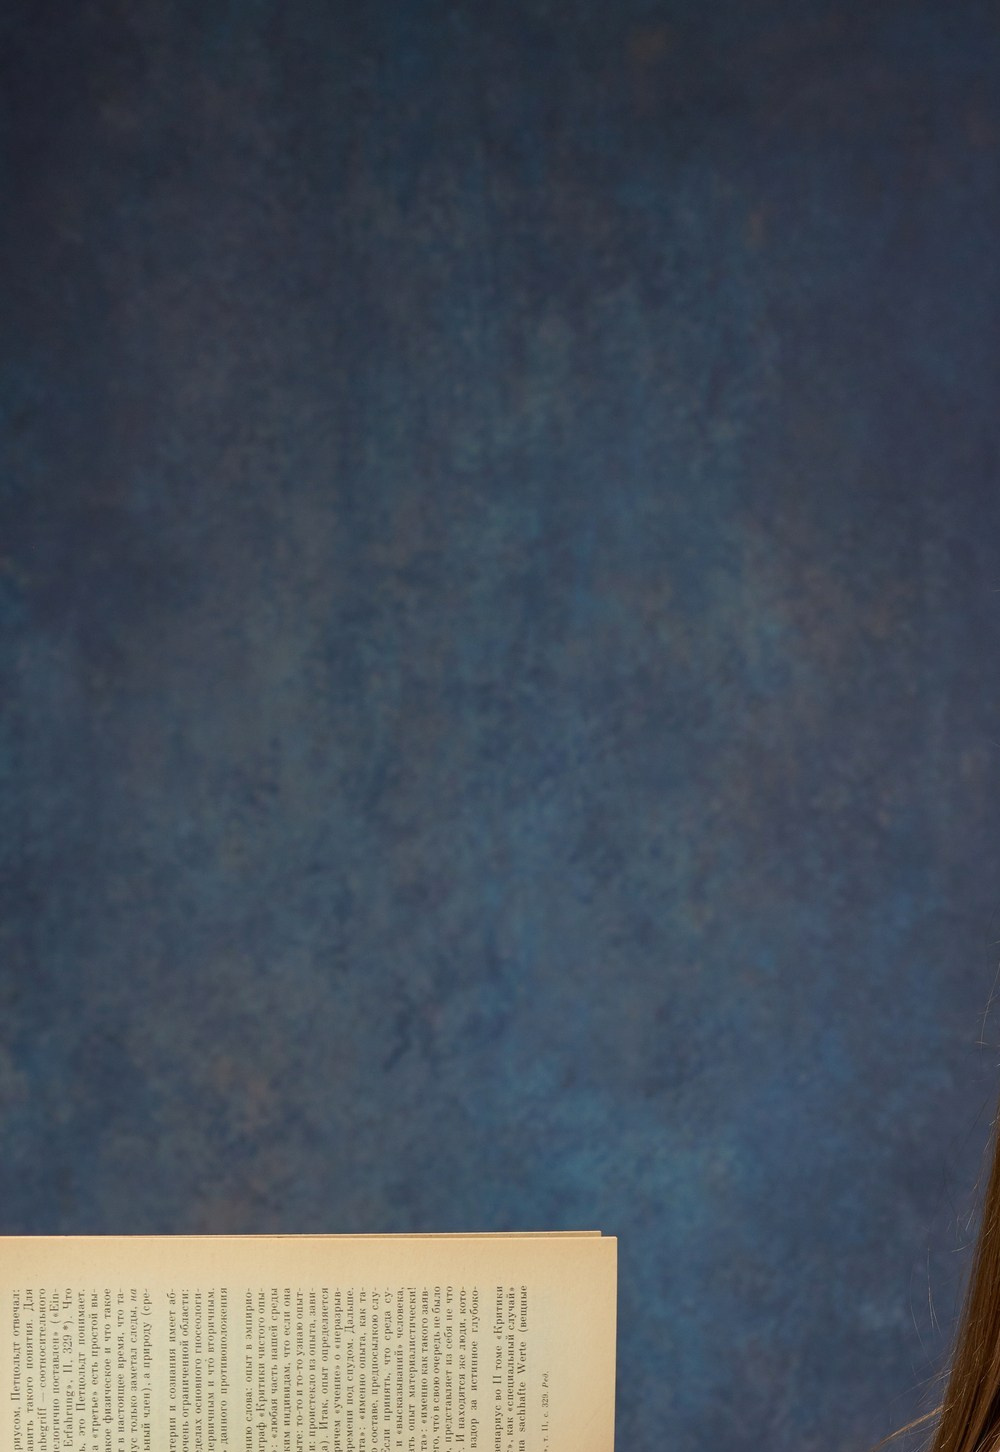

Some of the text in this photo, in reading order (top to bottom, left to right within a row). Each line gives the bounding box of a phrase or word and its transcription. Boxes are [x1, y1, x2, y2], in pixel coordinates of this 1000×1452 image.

[62, 1288, 72, 1309] Что
[246, 1288, 255, 1340] эмпирио-
[469, 1286, 481, 1333] глубоко-
[39, 1288, 47, 1388] соотносительного
[62, 1334, 73, 1354] 329
[220, 1288, 230, 1394] противоположения
[283, 1340, 291, 1358] что
[517, 1341, 527, 1373] Werte
[10, 1341, 22, 1401] Петцольдт
[75, 1352, 87, 1411] Петцольдт
[130, 1348, 138, 1391] заметал
[179, 1340, 192, 1418] ограниченной
[245, 1356, 253, 1383] опыт
[130, 1395, 138, 1433] только
[220, 1400, 229, 1445] данного
[516, 1382, 526, 1432] sachhafte
[471, 1418, 480, 1448] вздор
